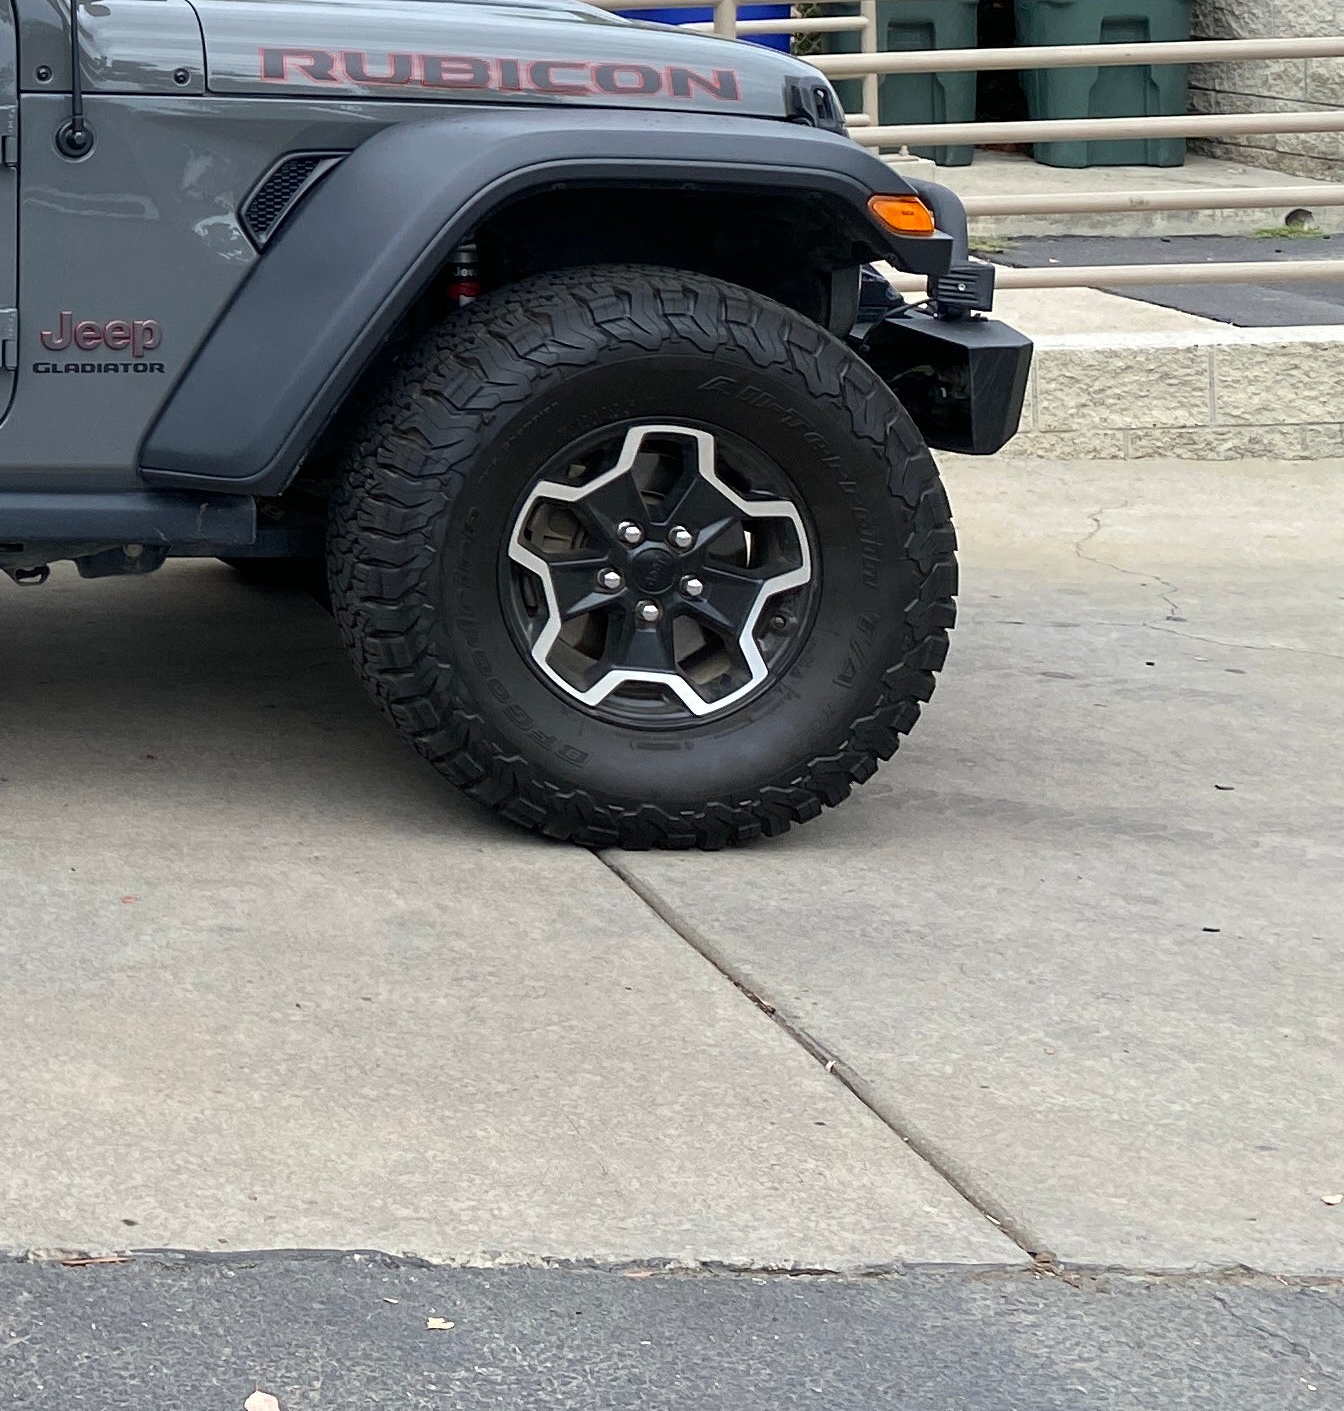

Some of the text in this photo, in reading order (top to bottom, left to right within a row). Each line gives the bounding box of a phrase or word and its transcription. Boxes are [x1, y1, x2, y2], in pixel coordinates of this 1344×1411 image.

[258, 46, 742, 101] RUBICON
[40, 310, 163, 358] Jeep
[32, 362, 166, 374] GLADIATOR
